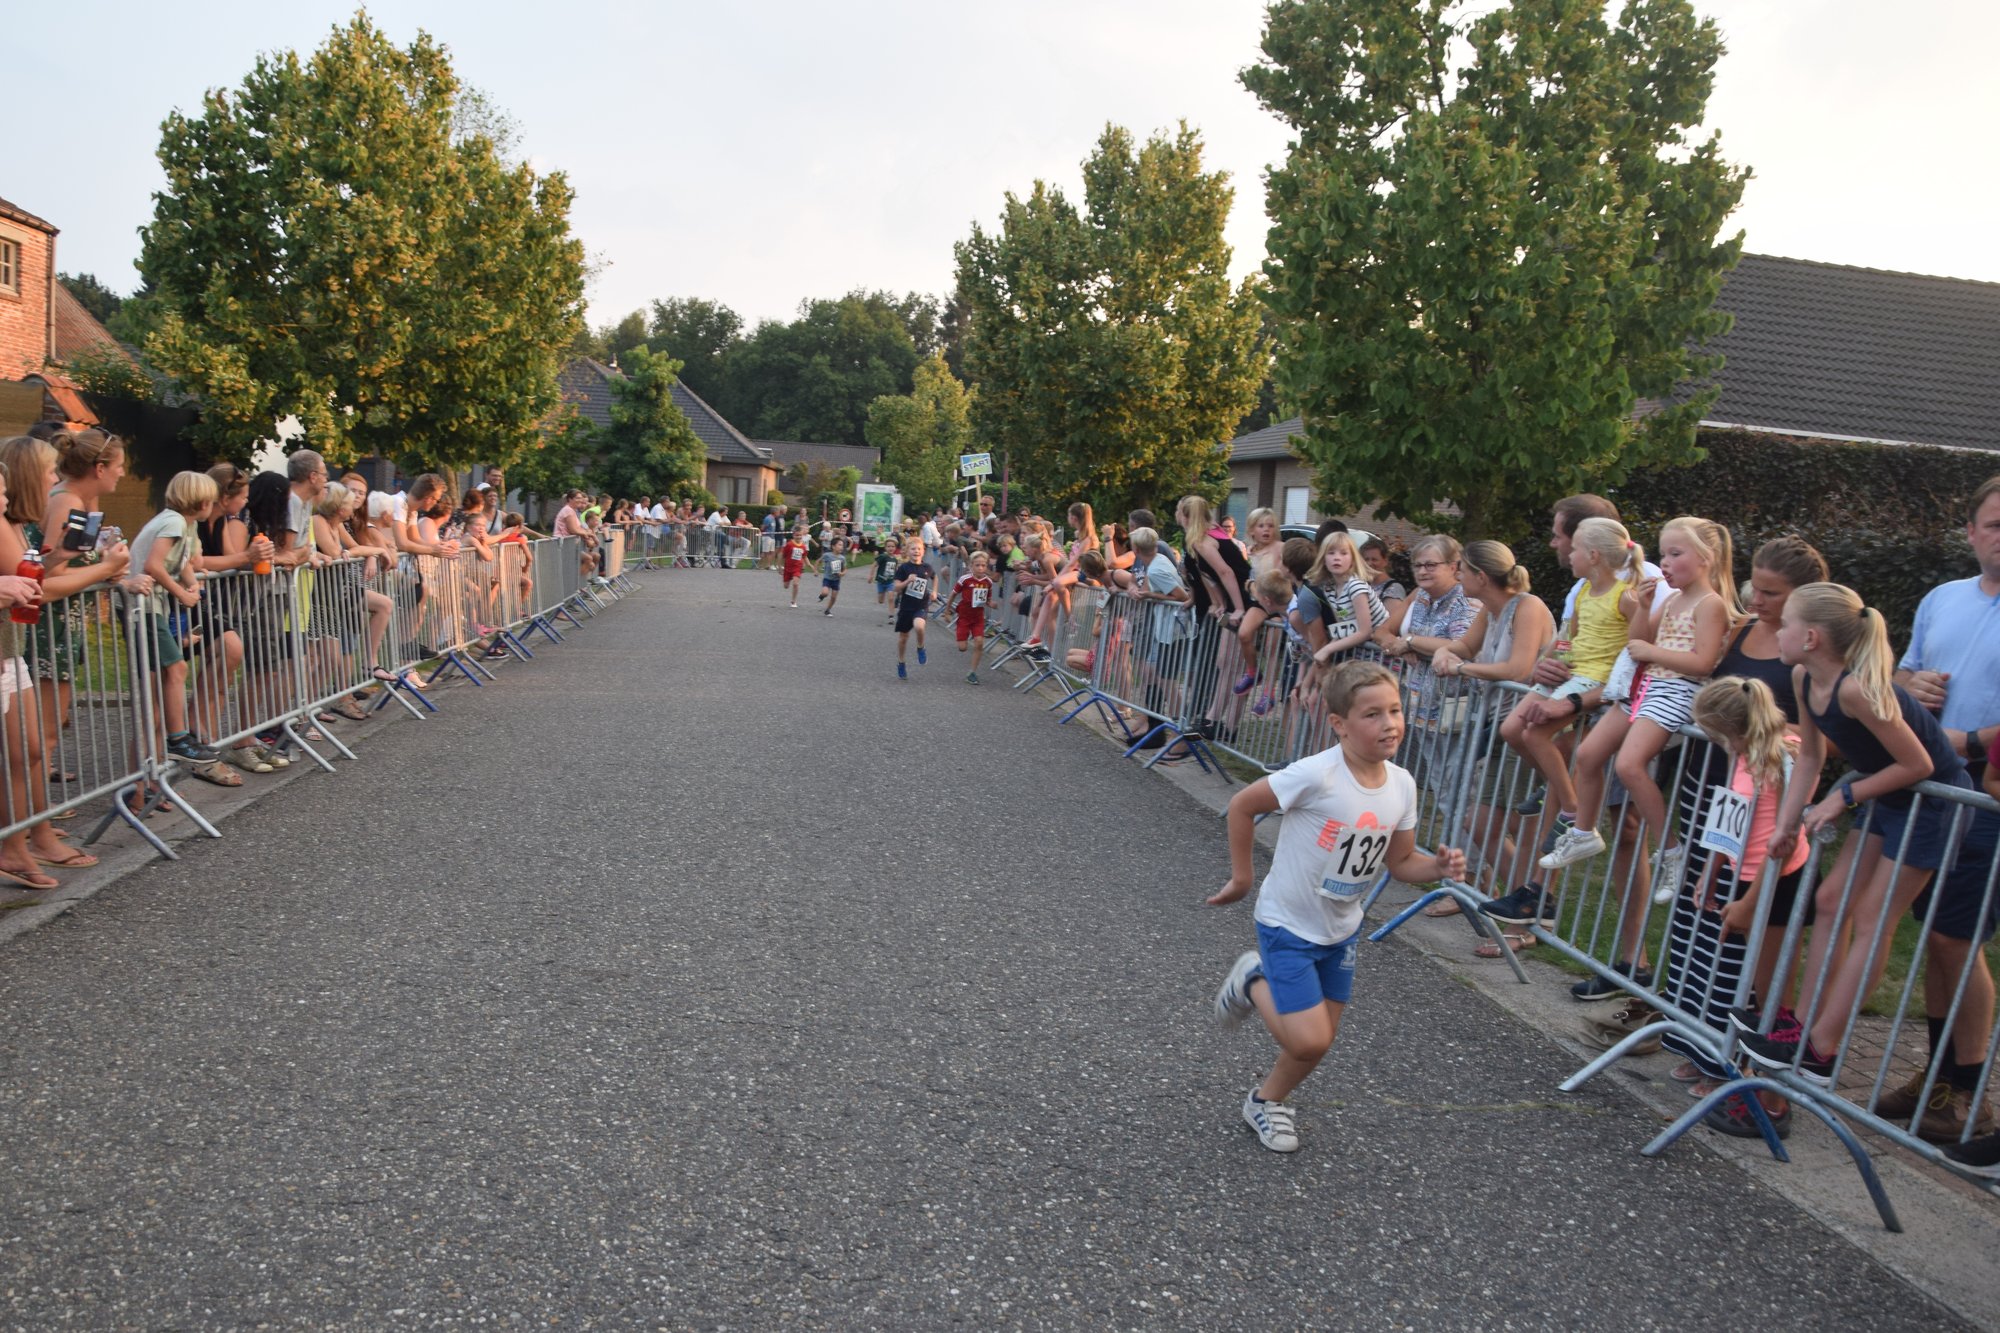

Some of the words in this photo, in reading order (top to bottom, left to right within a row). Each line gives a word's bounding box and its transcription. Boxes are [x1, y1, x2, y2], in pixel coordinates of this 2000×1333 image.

[963, 458, 989, 471] START
[910, 579, 926, 592] 126
[1716, 794, 1747, 838] 170
[1337, 834, 1387, 877] 132
